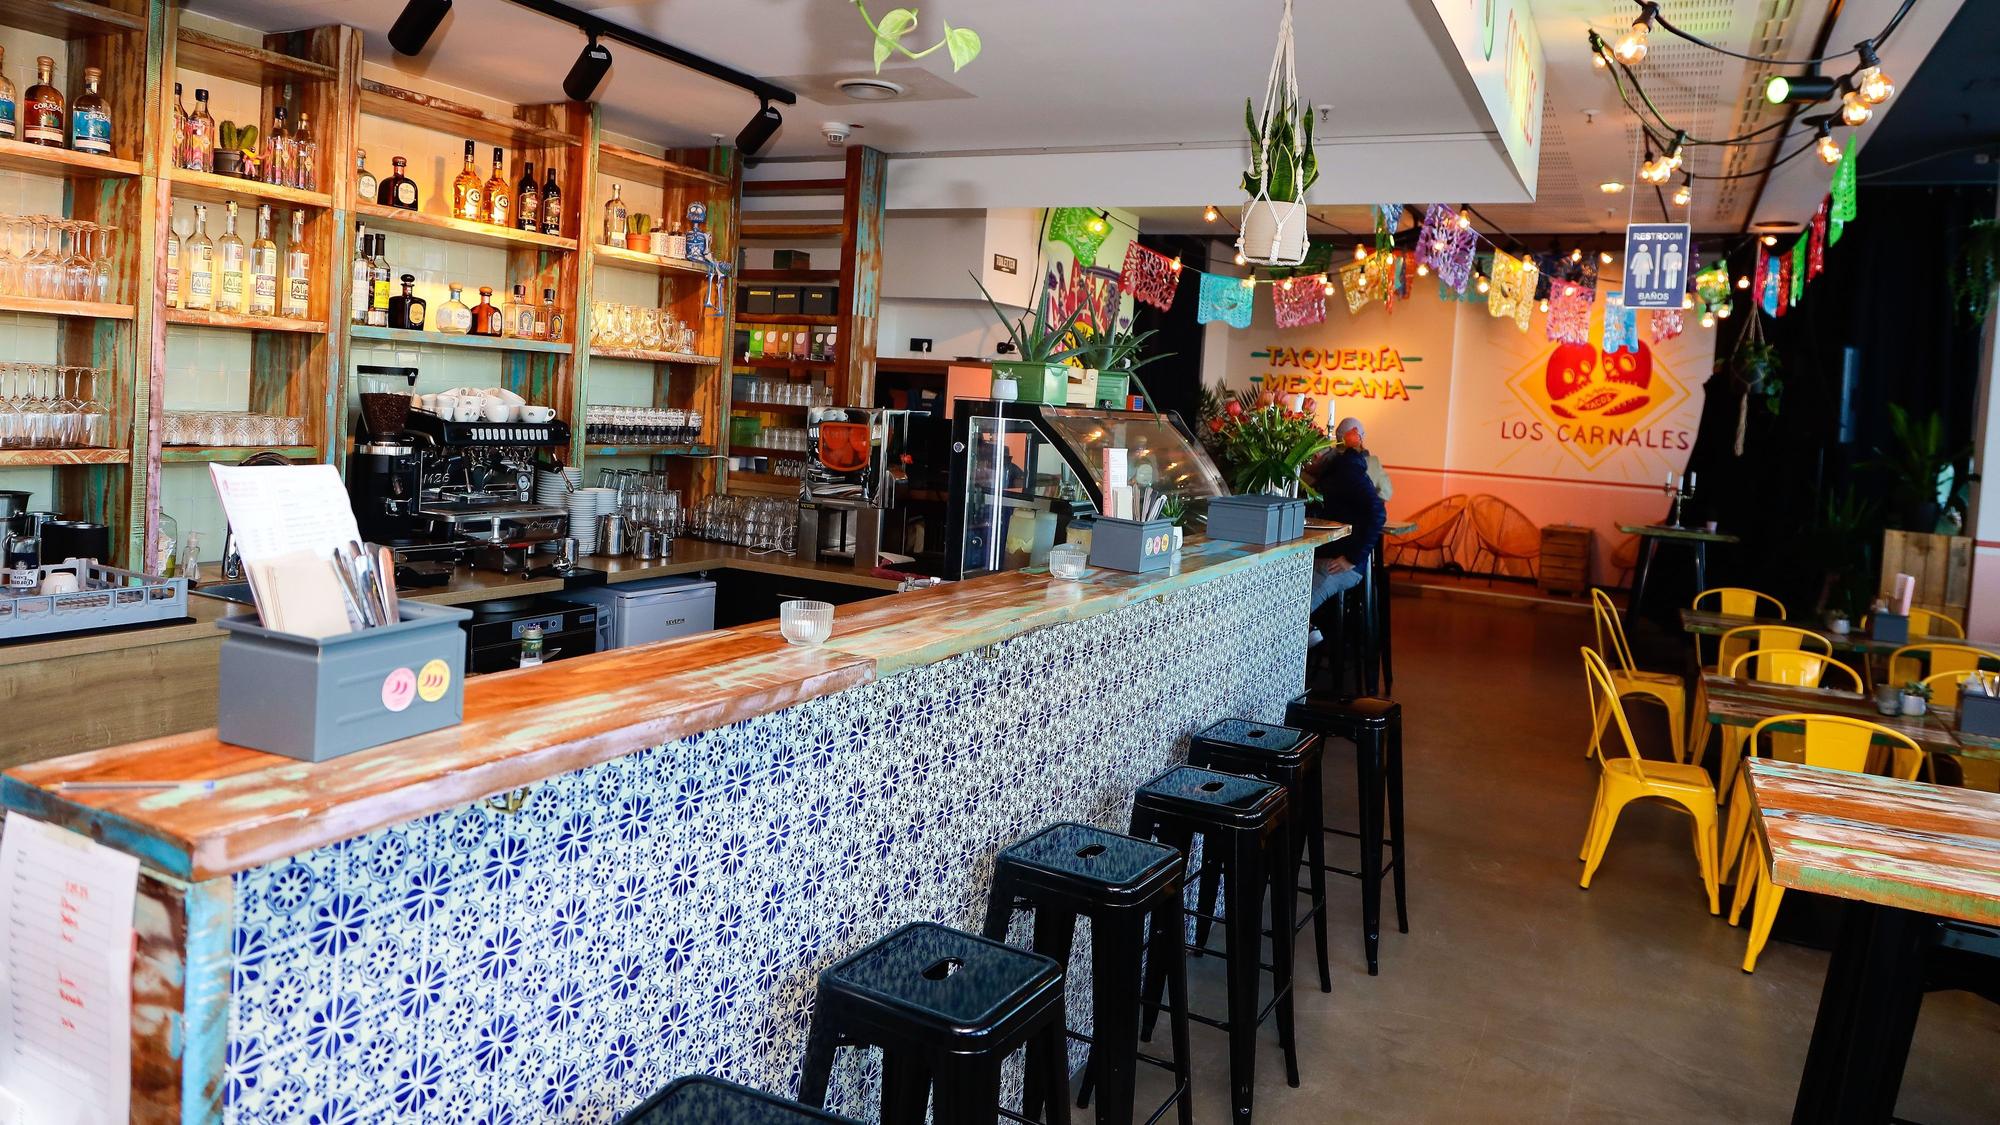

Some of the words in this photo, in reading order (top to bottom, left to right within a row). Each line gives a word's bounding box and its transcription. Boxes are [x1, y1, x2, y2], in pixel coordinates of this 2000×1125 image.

[1633, 232, 1683, 241] RESTROOM
[1638, 291, 1669, 300] BAÑOS
[1265, 344, 1405, 375] TAQUERÍA
[1262, 373, 1410, 401] MEXICANA
[1585, 393, 1612, 408] TACOS
[1500, 420, 1544, 441] LOS
[1557, 423, 1690, 450] CARNALES
